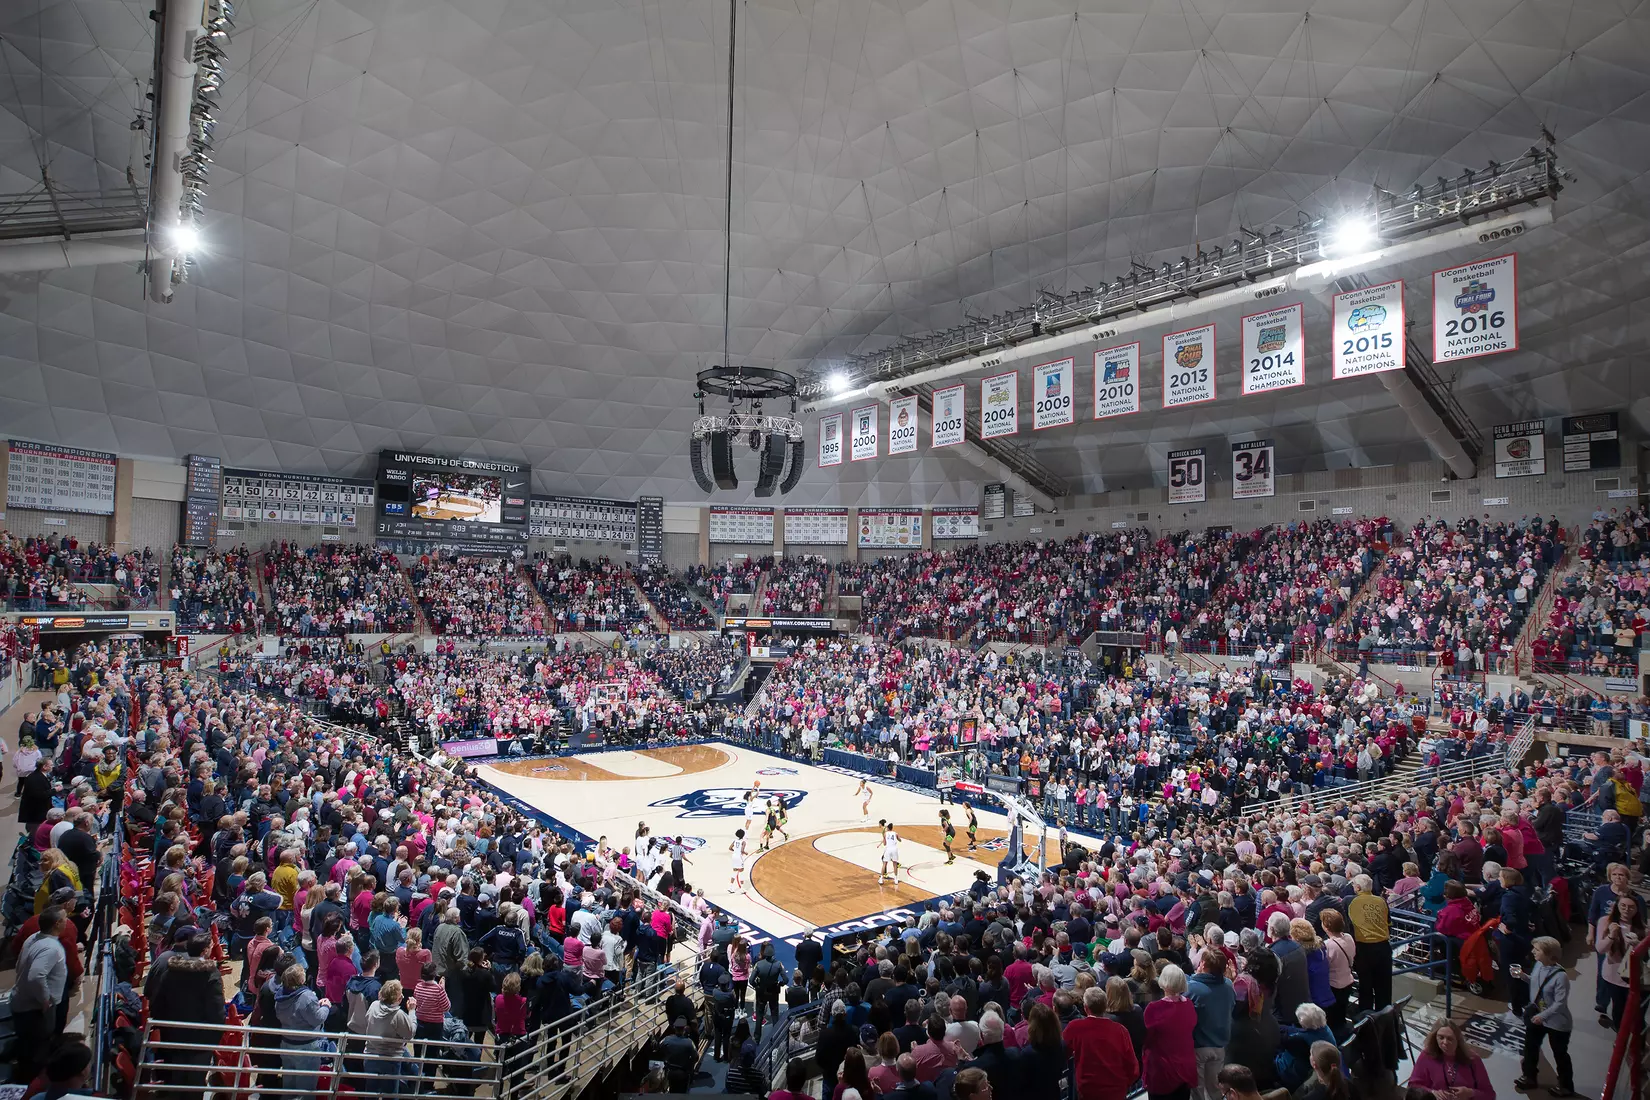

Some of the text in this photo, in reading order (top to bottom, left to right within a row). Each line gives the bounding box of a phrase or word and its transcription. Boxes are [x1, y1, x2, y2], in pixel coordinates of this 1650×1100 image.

[1441, 259, 1507, 278] UConn Women's
[1453, 269, 1495, 284] Basketball
[1340, 284, 1396, 301] UConn Women's
[1458, 292, 1492, 305] FINAL FOUR
[1350, 294, 1385, 306] Basketball
[1268, 307, 1296, 317] Women's
[1256, 316, 1287, 328] Basketball
[1446, 311, 1505, 337] 2016
[1186, 328, 1210, 336] Women's
[1175, 336, 1202, 345] Basketball
[1343, 332, 1392, 355] 2015
[1448, 332, 1502, 347] NATIONAL
[1114, 345, 1135, 353] Women's
[1444, 341, 1507, 358] CHAMPIONS
[1105, 352, 1128, 361] Basketball
[1250, 352, 1294, 373] 2014
[1346, 352, 1391, 364] NATIONAL
[1342, 360, 1395, 374] CHAMPIONS
[1170, 368, 1208, 388] 2013
[1253, 370, 1292, 382] NATIONAL
[1172, 385, 1206, 396] NATIONAL
[1250, 377, 1296, 391] CHAMPIONS
[1099, 384, 1133, 401] 2010
[1169, 393, 1209, 404] CHAMPIONS
[1037, 396, 1070, 413] 2009
[1101, 399, 1131, 408] NATIONAL
[984, 407, 1014, 423] 2004
[1040, 411, 1066, 420] NATIONAL
[1099, 406, 1134, 416] CHAMPIONS
[936, 418, 962, 433] 2003
[987, 421, 1011, 430] NATIONAL
[1038, 417, 1069, 427] CHAMPIONS
[1494, 421, 1543, 434] GENO AURIEMMA
[892, 427, 914, 440] 2002
[985, 427, 1013, 436] CHAMPIONS
[853, 435, 876, 448] 2000
[14, 448, 62, 458] TOURNAMENT
[15, 442, 110, 458] NCAA CHAMPIONSHIP
[822, 443, 839, 454] 1995
[395, 455, 447, 465] UNIVERSITY
[462, 461, 520, 473] CONNECTICUT
[1236, 450, 1270, 482] 34
[1171, 458, 1202, 487] 50
[226, 486, 240, 494] 24
[286, 490, 298, 498] 52
[451, 741, 492, 754] genius3D
